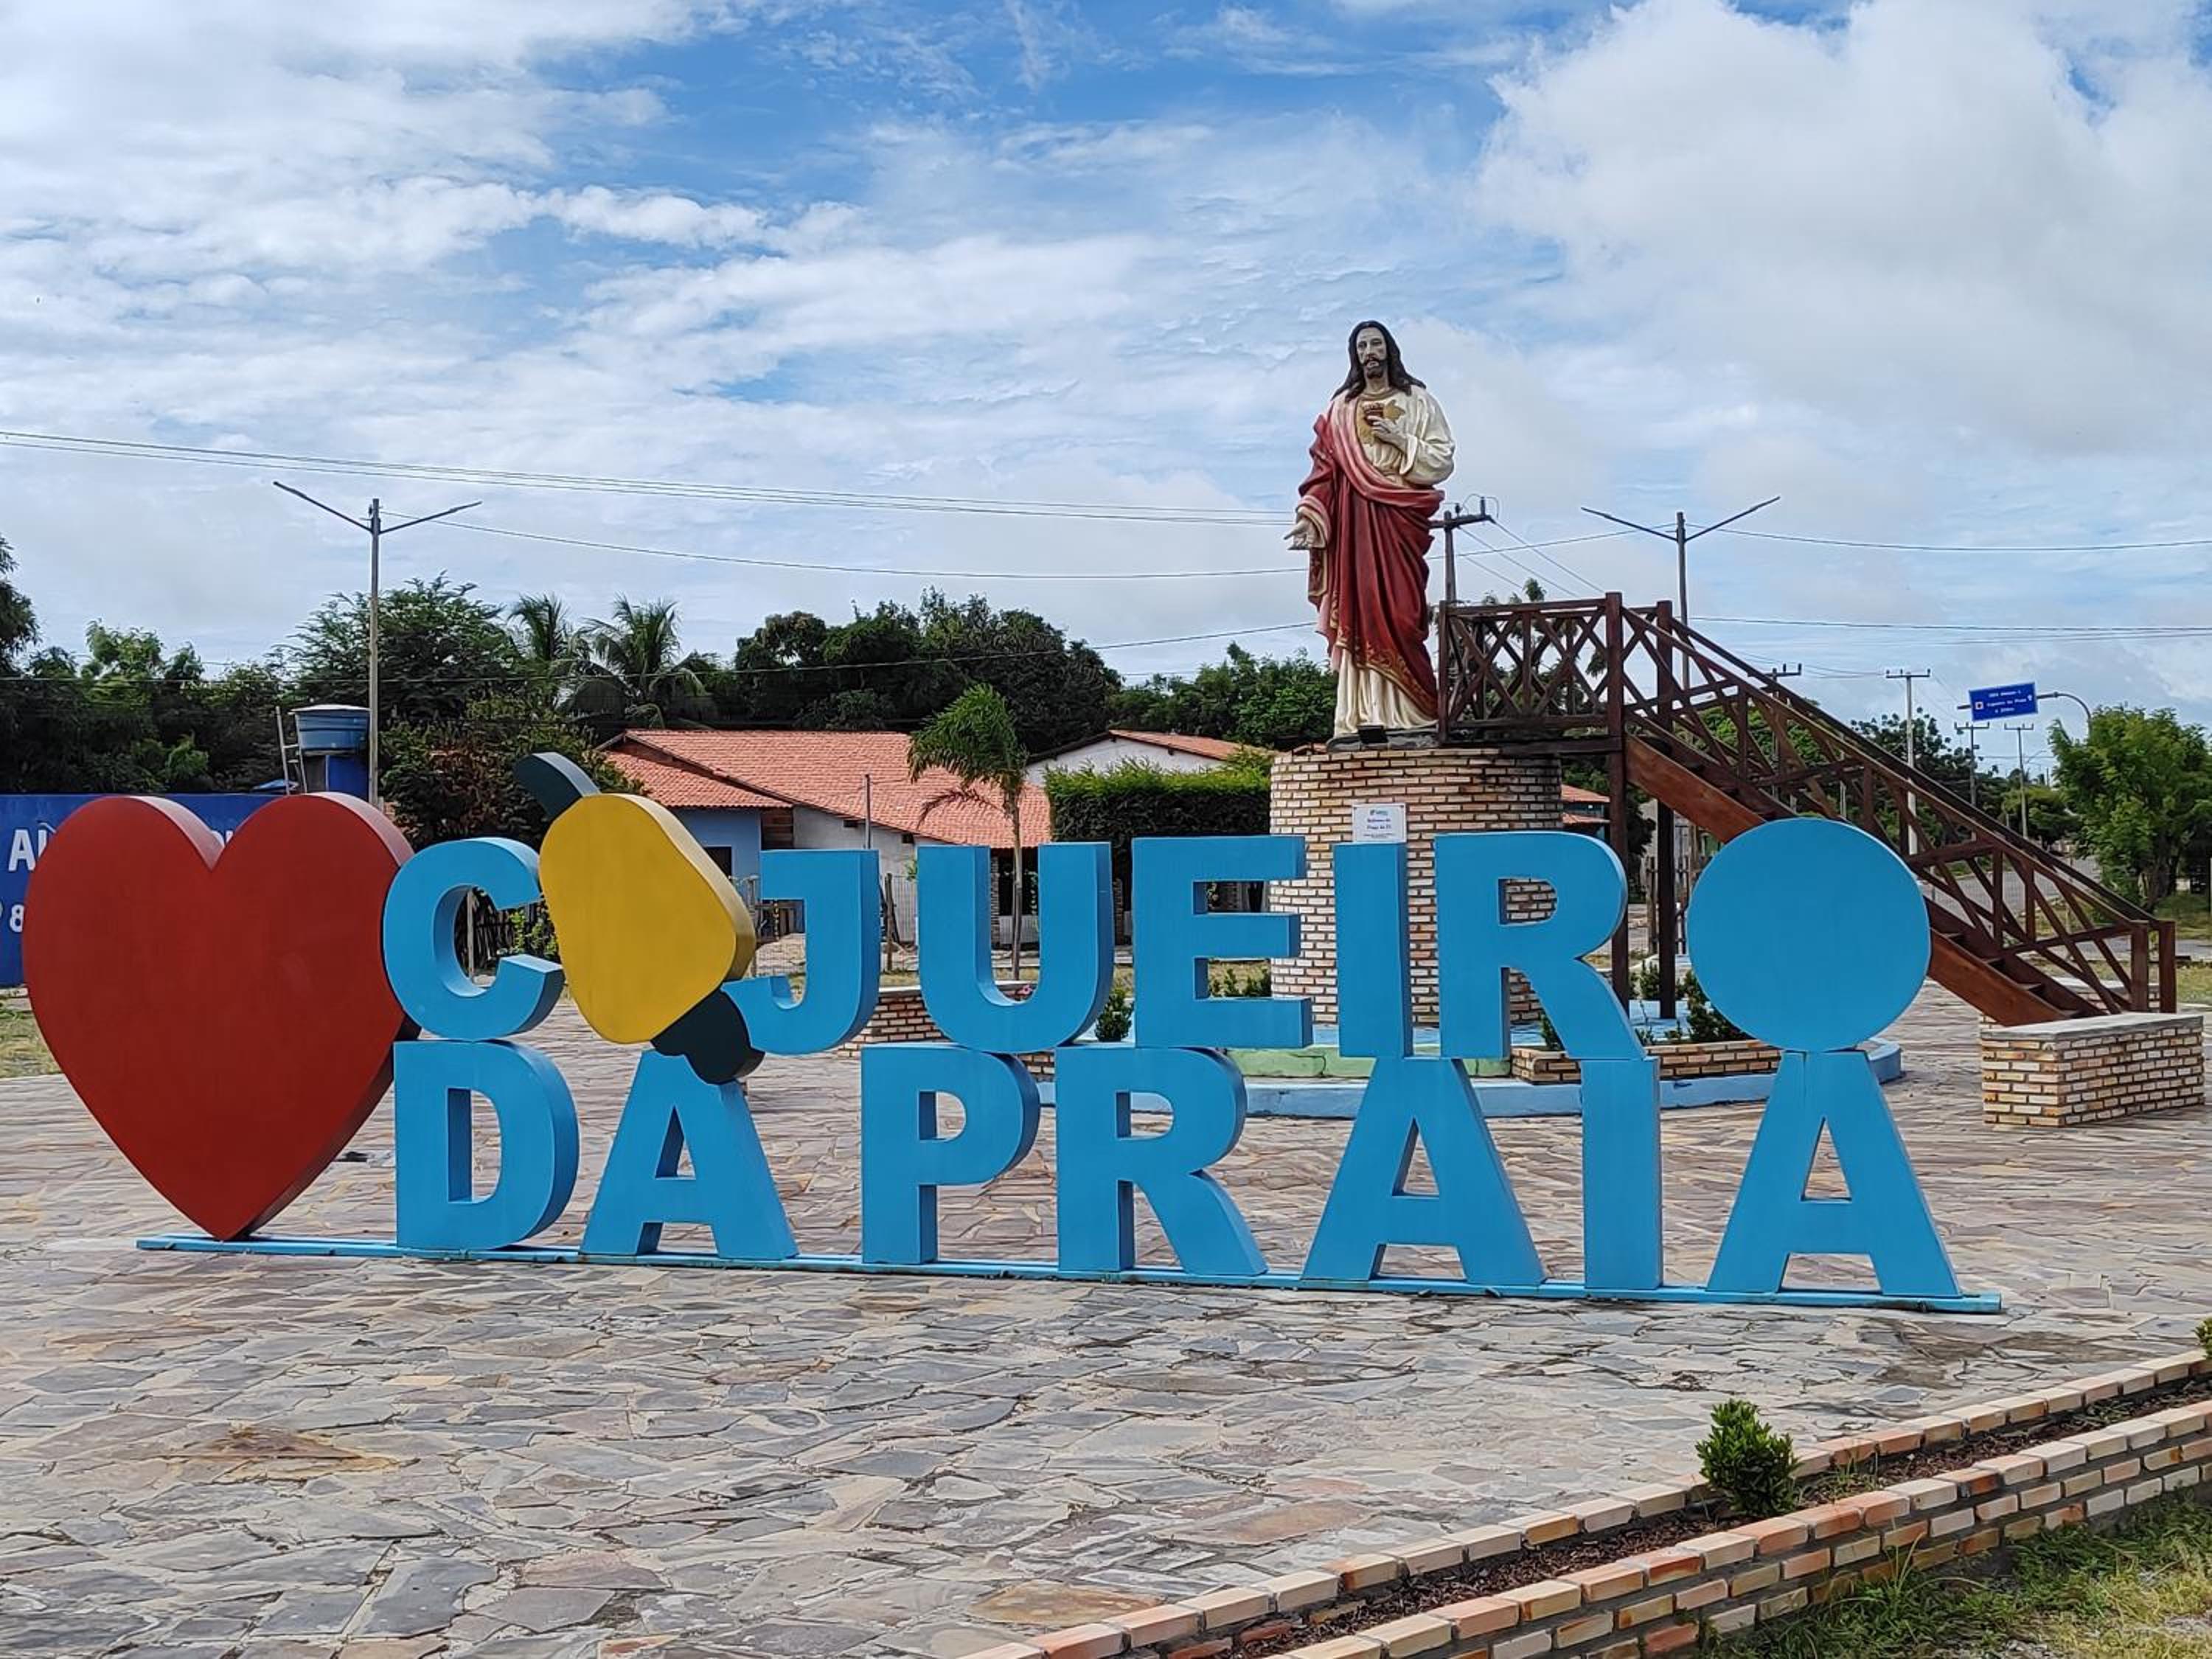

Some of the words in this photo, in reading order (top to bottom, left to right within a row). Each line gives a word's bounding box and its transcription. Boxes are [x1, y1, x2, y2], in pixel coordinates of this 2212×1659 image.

[383, 817, 1932, 1062] CJUEIRO
[394, 1040, 799, 1261] DA
[860, 1044, 1963, 1300] PRAIA
